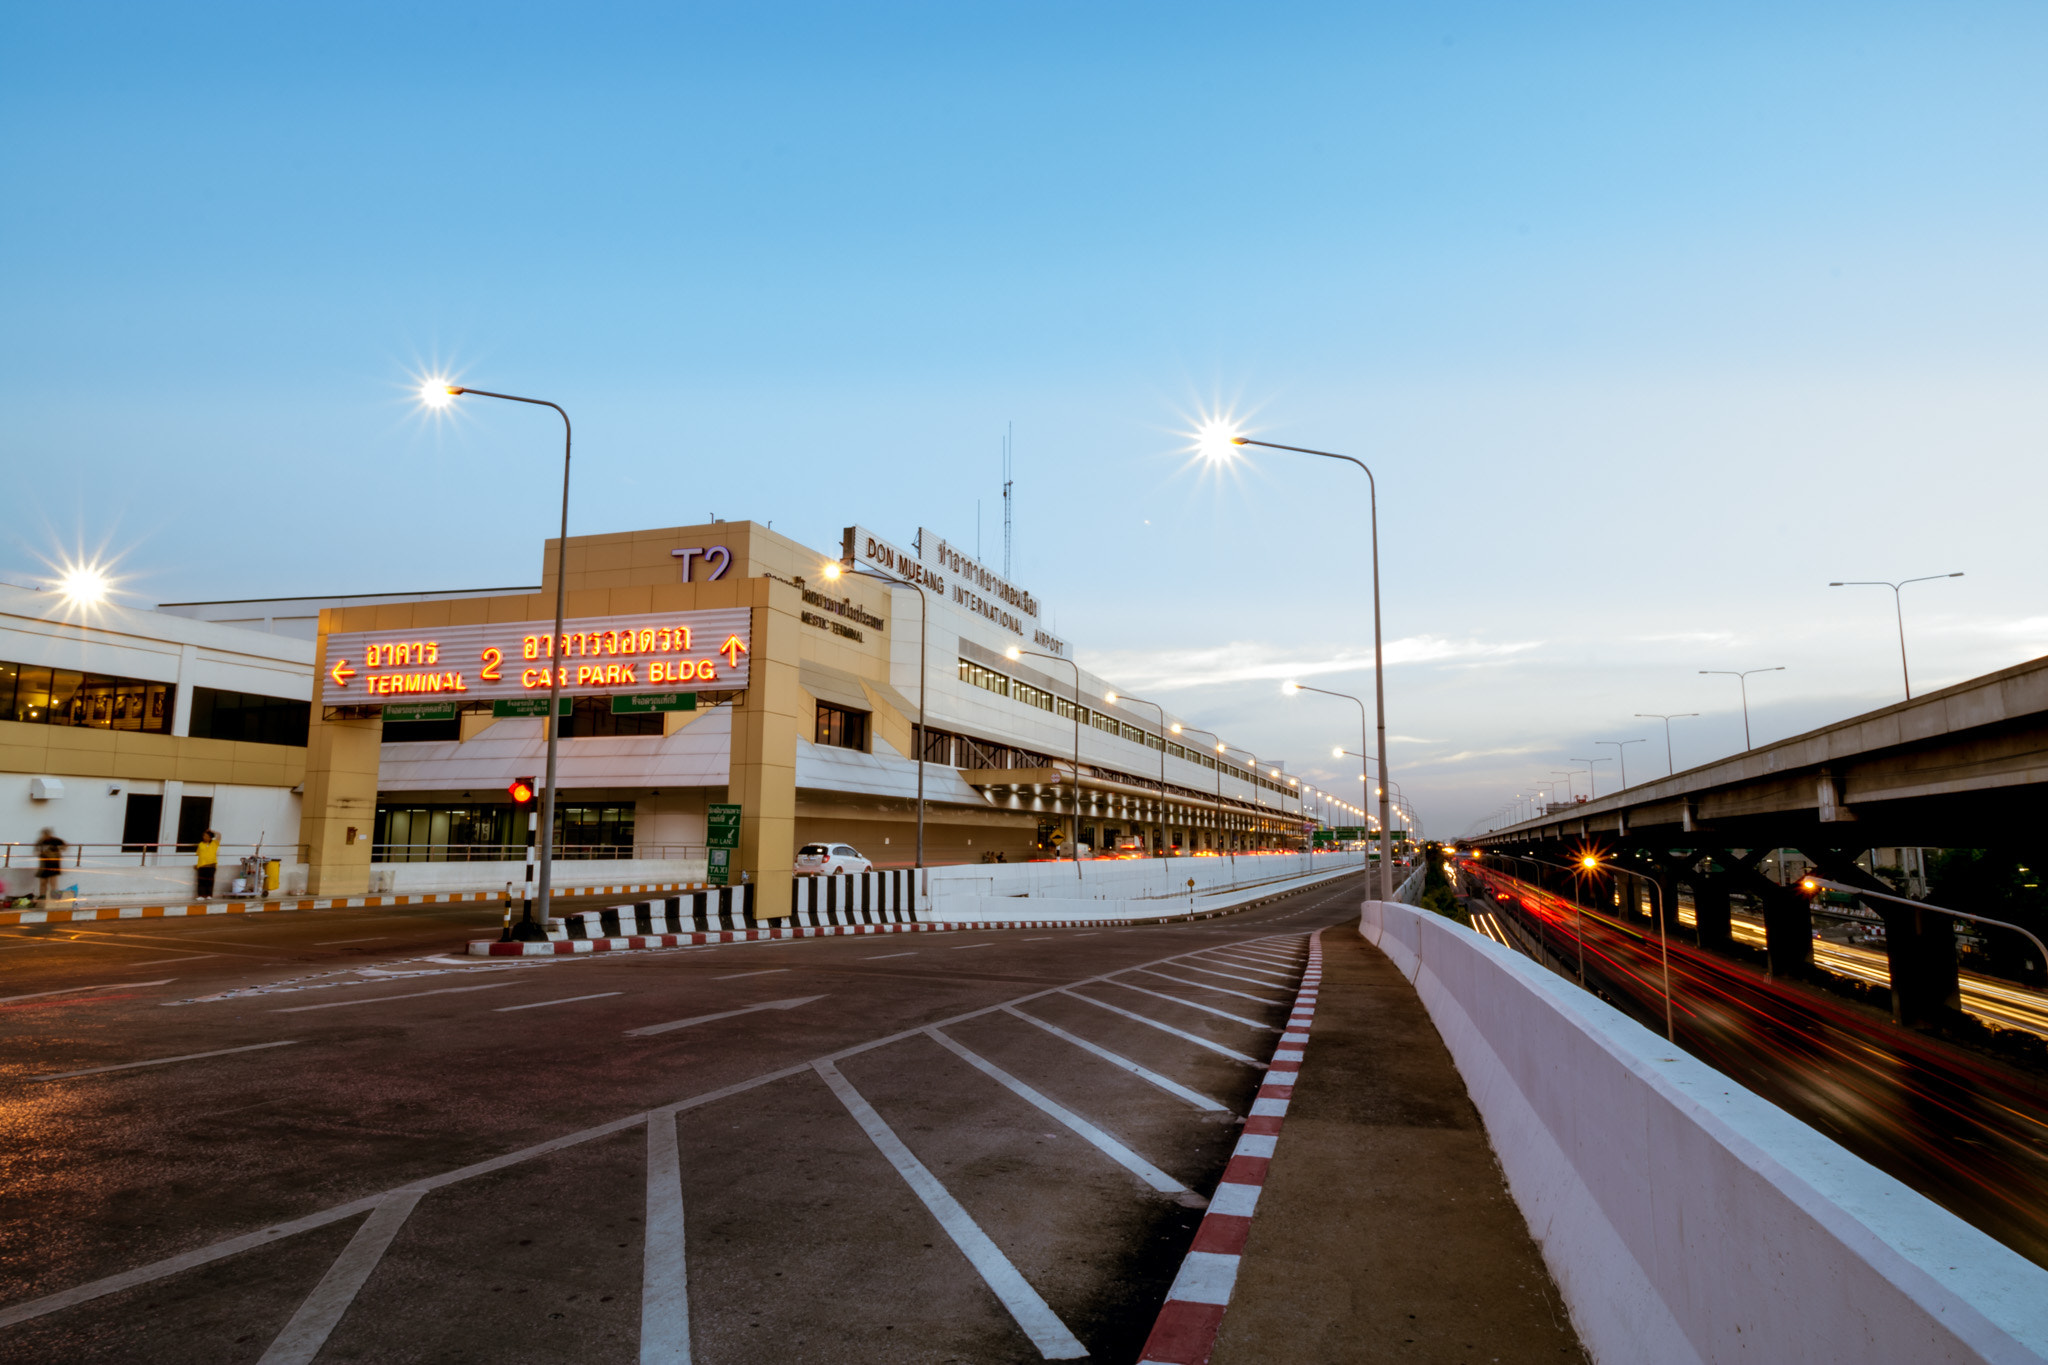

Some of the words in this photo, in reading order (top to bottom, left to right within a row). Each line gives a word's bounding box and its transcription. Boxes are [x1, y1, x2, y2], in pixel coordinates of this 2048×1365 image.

[672, 545, 732, 583] T2
[938, 539, 1037, 618] ท่าอากาศยานดอนเมือง
[866, 537, 894, 569] DON
[899, 554, 944, 595] MUEANG
[953, 584, 1024, 636] INTERNATIONAL
[1033, 629, 1064, 656] AIRPORT
[523, 626, 692, 660] อาคารจอดรถ
[801, 610, 830, 630] MESTIC
[830, 621, 864, 643] TERMINAL
[366, 641, 439, 667] อาคาร
[480, 647, 503, 680] 2
[366, 672, 467, 695] TERMINAL
[522, 667, 568, 689] CAR
[577, 663, 638, 686] PARK
[709, 866, 728, 874] TAXI
